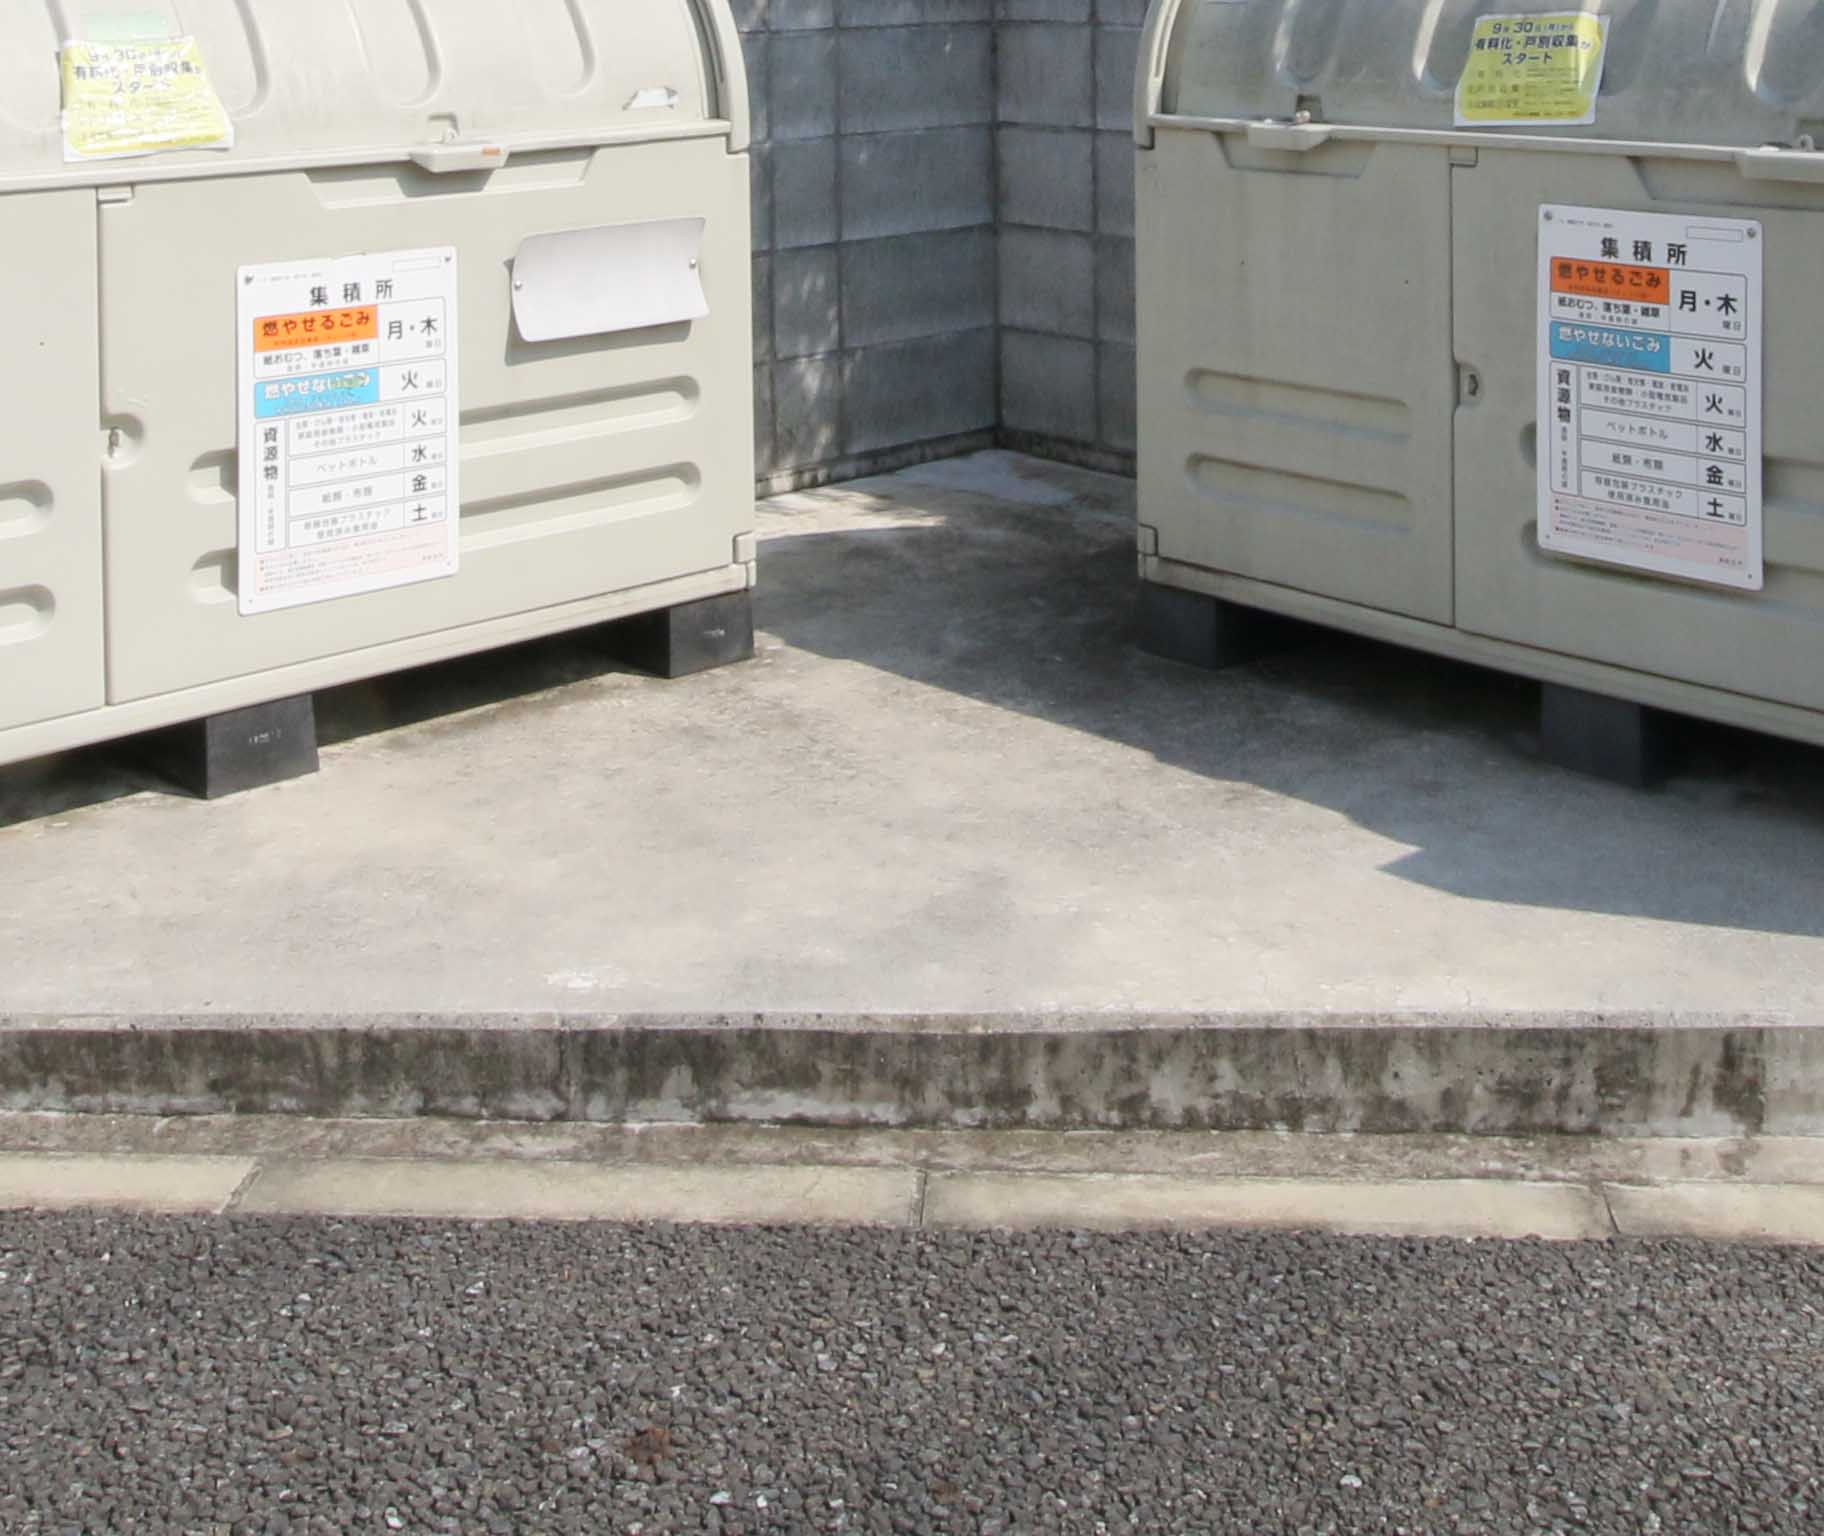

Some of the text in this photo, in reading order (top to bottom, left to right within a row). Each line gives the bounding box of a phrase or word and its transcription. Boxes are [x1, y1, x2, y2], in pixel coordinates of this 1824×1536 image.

[1502, 52, 1553, 64] スタート
[1601, 237, 1688, 265] 集積所
[1558, 261, 1661, 289] 燃やせるごみ
[310, 279, 393, 306] 集積所
[1679, 290, 1738, 315] 月・木
[262, 311, 370, 337] 燃やせるごみ
[387, 318, 438, 340] 月・木
[1722, 320, 1741, 331] 曜日
[1558, 326, 1661, 352] 燃やせないごみ
[1694, 348, 1714, 370] 火
[401, 370, 419, 390] 火
[1557, 369, 1571, 424] 資源物
[1705, 393, 1723, 414] 火
[411, 409, 427, 427] 火
[1607, 421, 1668, 440] ペットボトル
[1705, 432, 1724, 452] 水
[263, 427, 278, 480] 資源物
[411, 445, 427, 463] 水
[411, 474, 427, 492] 金
[1705, 465, 1724, 486] 金
[411, 504, 428, 522] 土
[1706, 498, 1725, 518] 土
